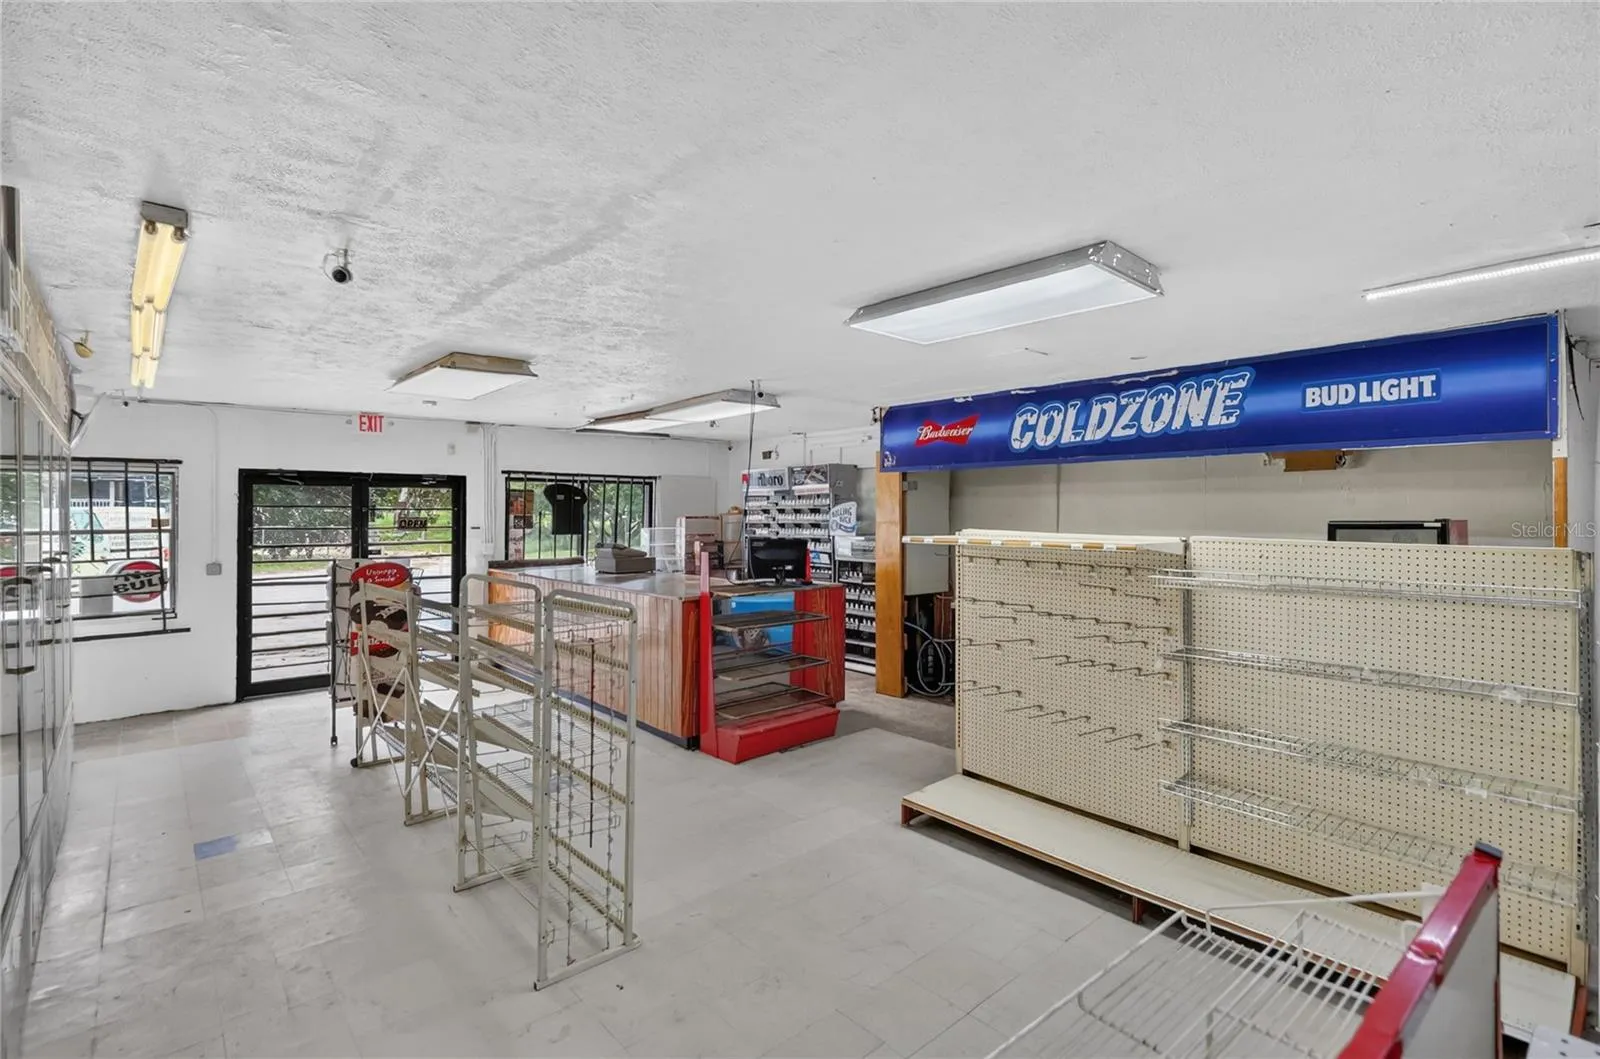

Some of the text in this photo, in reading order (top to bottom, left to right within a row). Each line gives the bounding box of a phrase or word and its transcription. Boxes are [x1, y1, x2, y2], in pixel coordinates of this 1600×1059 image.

[1305, 384, 1357, 408] BUD
[1010, 371, 1251, 450] COLDZONE
[359, 414, 385, 432] EXIT
[916, 424, 974, 441] Budweiser
